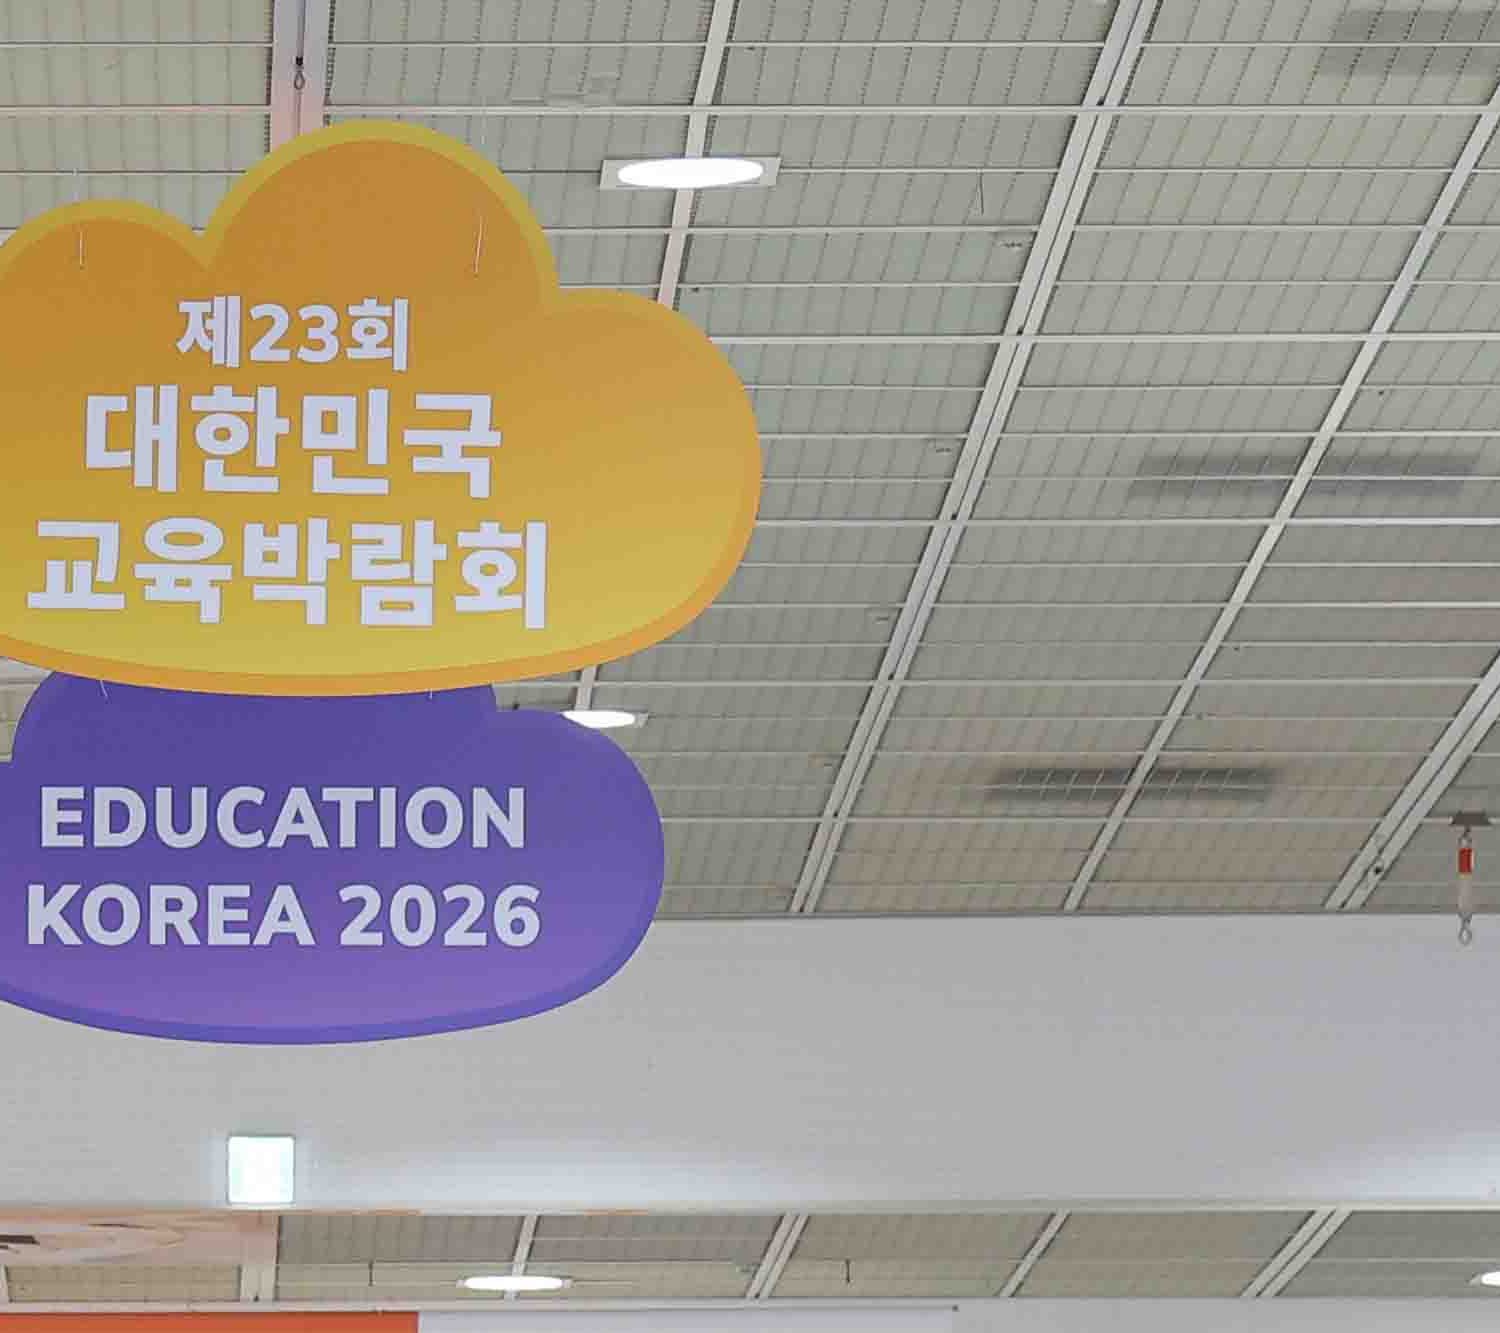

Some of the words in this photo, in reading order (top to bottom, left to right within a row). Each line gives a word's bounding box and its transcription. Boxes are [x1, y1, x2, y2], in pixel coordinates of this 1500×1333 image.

[176, 296, 408, 371] 제23회
[86, 384, 501, 498] 대한민국
[28, 518, 547, 629] 교육박람회
[42, 787, 524, 848] EDUCATION
[29, 884, 315, 945] KOREA
[340, 885, 539, 946] 2026
